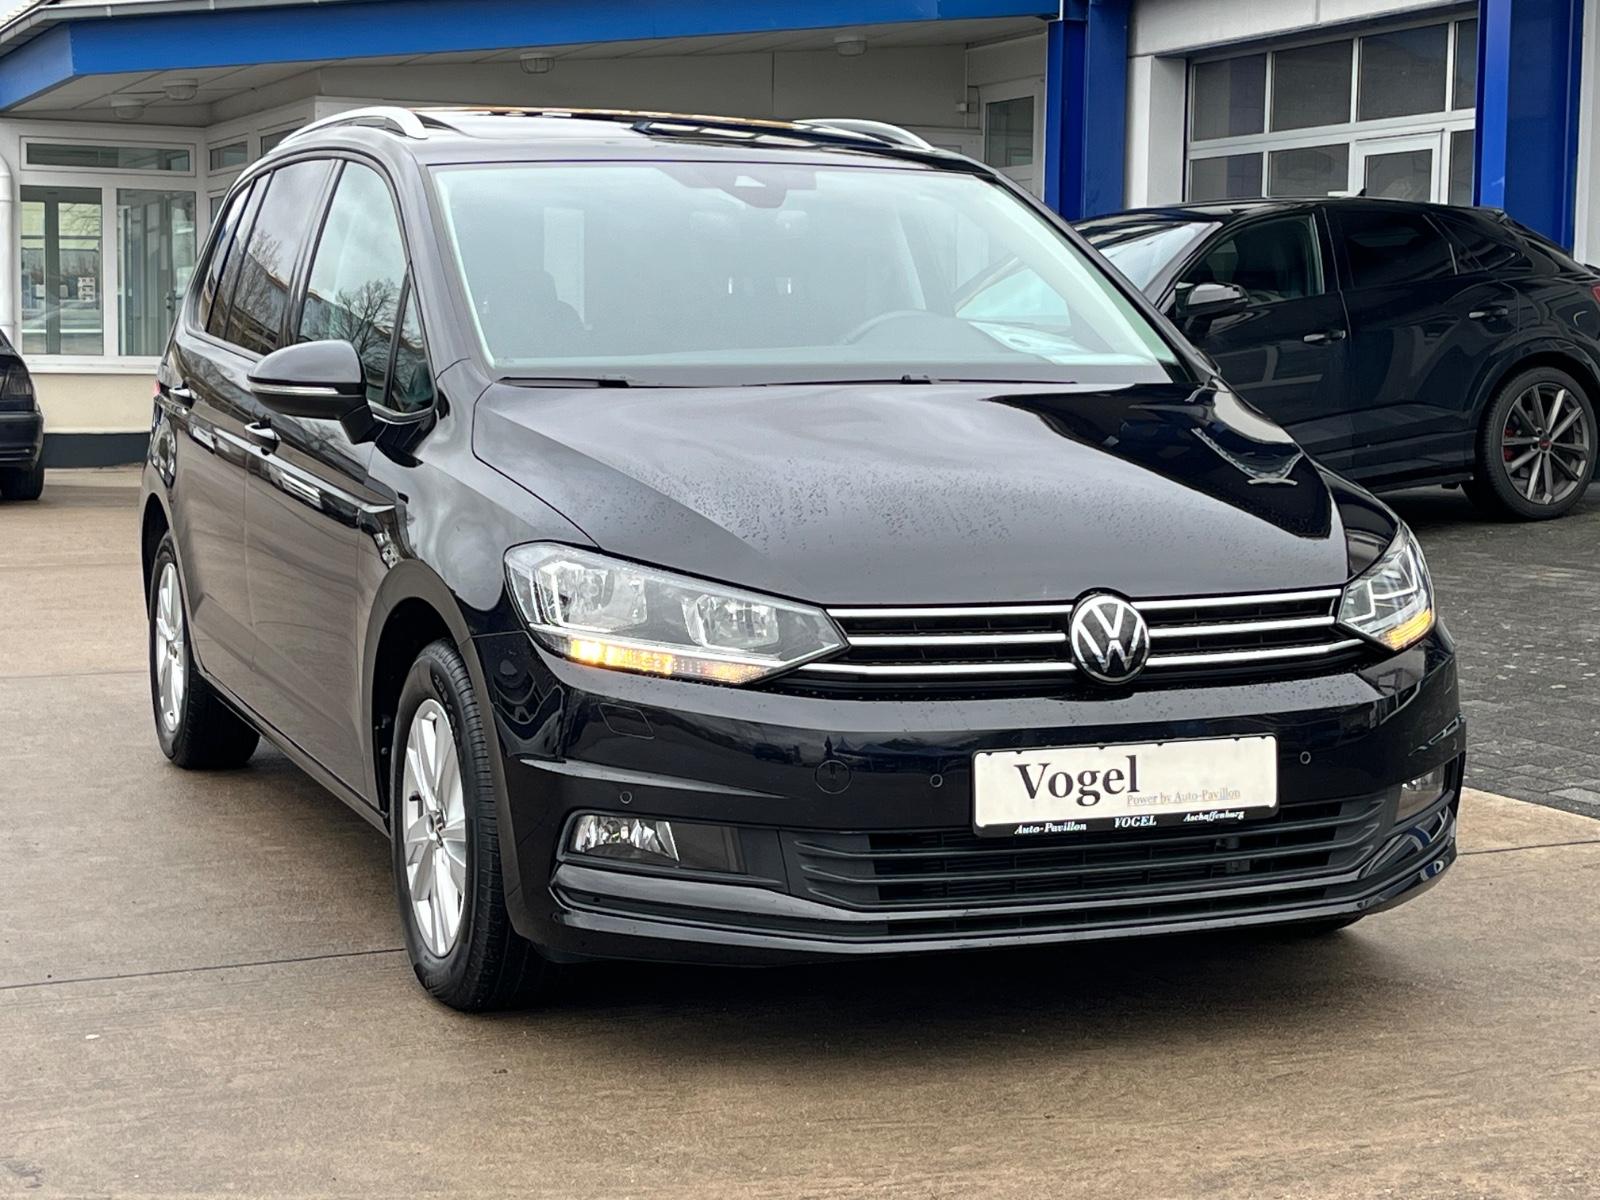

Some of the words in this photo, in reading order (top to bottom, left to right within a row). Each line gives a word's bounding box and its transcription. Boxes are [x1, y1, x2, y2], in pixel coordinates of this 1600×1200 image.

[1014, 755, 1140, 807] Vogel
[1127, 794, 1158, 806] Power
[1160, 791, 1173, 805] by
[1174, 787, 1241, 803] Auto-Pavillon
[1014, 821, 1087, 835] Auto-Pavillon
[1114, 815, 1157, 828] VOGEL
[1183, 809, 1245, 822] Aschaffenburg
